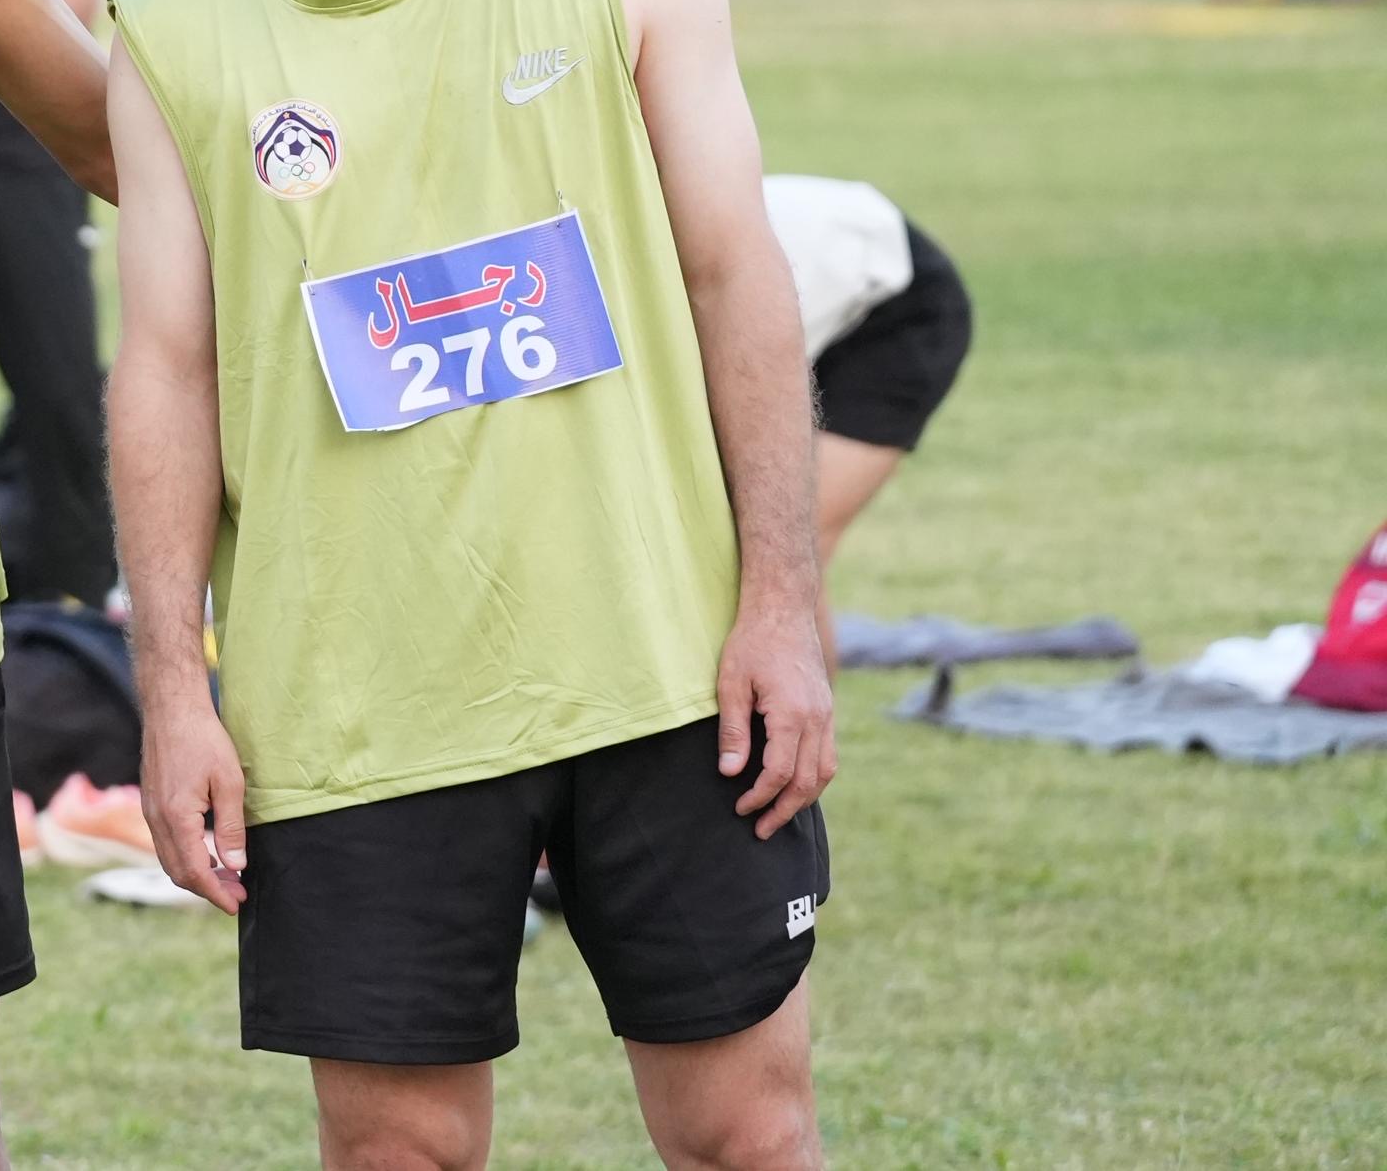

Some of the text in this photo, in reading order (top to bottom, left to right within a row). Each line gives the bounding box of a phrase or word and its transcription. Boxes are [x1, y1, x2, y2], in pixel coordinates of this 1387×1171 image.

[513, 46, 569, 81] NIKE
[367, 260, 547, 350] رجال
[390, 314, 558, 413] 276
[786, 893, 817, 929] RU
